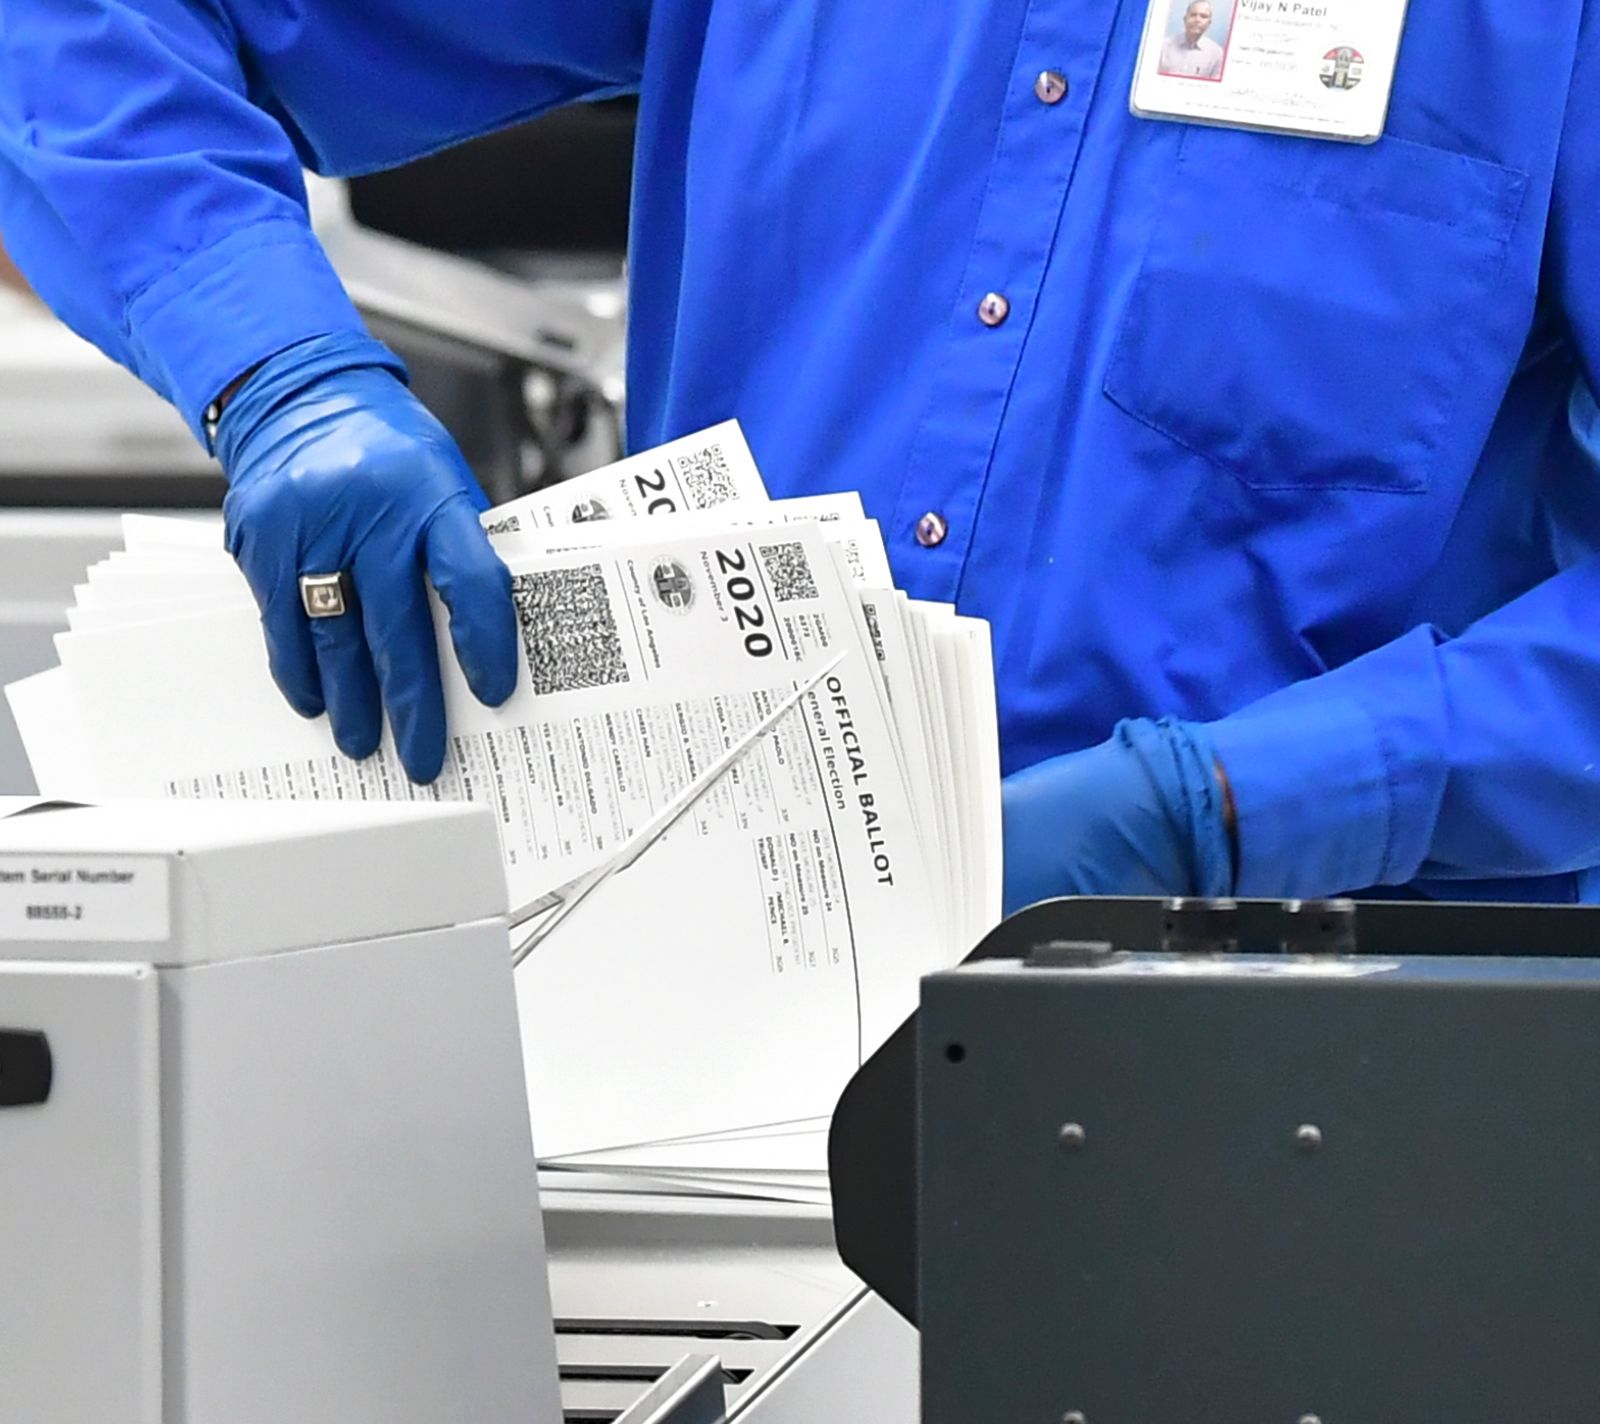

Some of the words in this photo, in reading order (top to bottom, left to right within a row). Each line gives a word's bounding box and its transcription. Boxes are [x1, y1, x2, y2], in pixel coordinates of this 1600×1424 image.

[1279, 2, 1288, 13] N
[1293, 4, 1327, 17] Patel
[634, 468, 676, 515] 20
[627, 559, 641, 594] County
[699, 550, 724, 611] November
[637, 597, 646, 607] of
[641, 609, 650, 626] Los
[715, 548, 773, 658] 2020
[646, 628, 661, 669] Angeles
[713, 696, 725, 723] LYDIA
[517, 726, 530, 755] JACKIE
[525, 757, 536, 784] LACEY
[605, 713, 616, 745] WENDY
[612, 748, 626, 792] CARRILLO
[772, 734, 785, 765] PAOLO
[804, 679, 831, 742] eneral
[822, 746, 846, 810] Election
[549, 754, 560, 792] Measure
[575, 726, 589, 769] ANTONIO
[584, 771, 598, 814] DELGADO
[826, 676, 868, 786] OFFICIAL
[858, 793, 894, 886] BALLOT
[495, 773, 510, 823] DELLINGER
[765, 836, 778, 876] DONALD
[789, 832, 797, 847] NO
[792, 849, 798, 862] on
[812, 829, 820, 844] NO
[815, 845, 822, 858] on
[31, 869, 71, 883] Serial
[76, 870, 134, 884] Number
[757, 837, 769, 870] TRUMP
[767, 896, 777, 925] PENCE
[795, 863, 806, 903] Measure
[818, 859, 829, 899] Measure
